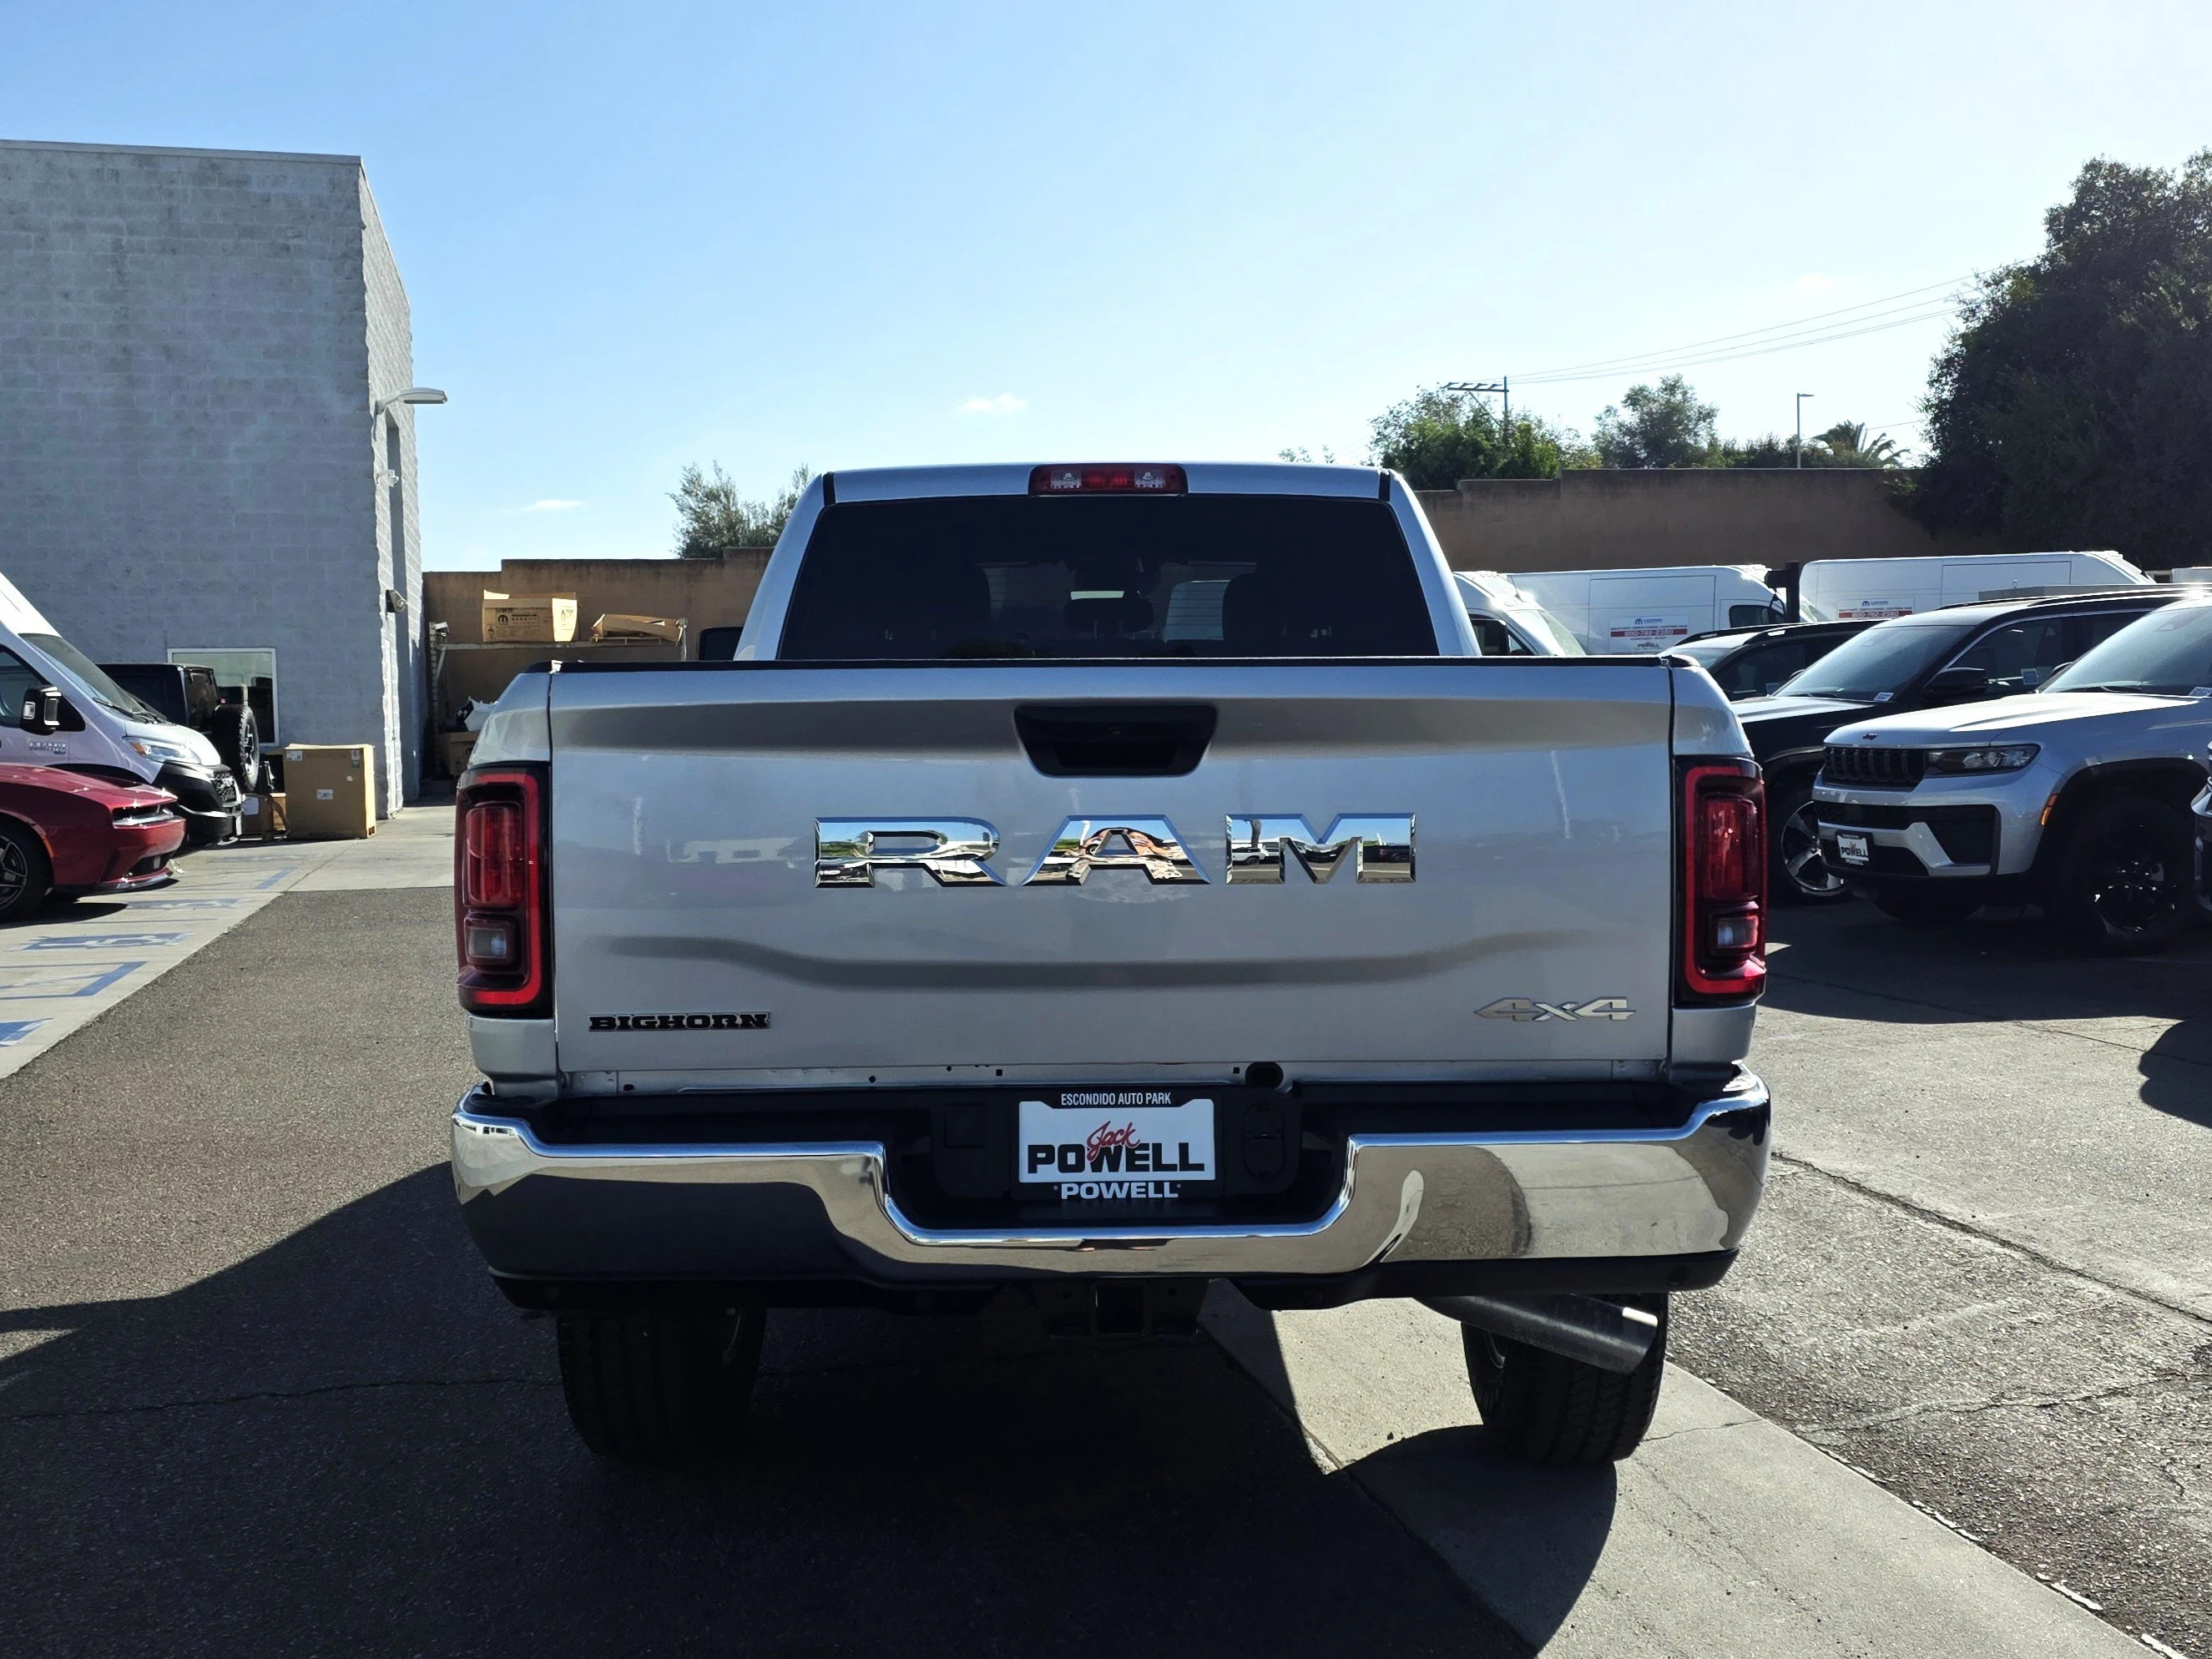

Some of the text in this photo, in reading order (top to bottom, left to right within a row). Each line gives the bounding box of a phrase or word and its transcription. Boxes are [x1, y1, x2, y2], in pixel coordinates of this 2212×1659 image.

[814, 813, 1417, 888] RAM
[588, 1011, 770, 1031] BIGHORN
[1061, 1092, 1171, 1106] ESCONDIDO AUTO PARK
[1086, 1120, 1141, 1162] Jack
[1028, 1142, 1204, 1174] POWELL
[1061, 1182, 1179, 1200] POWELL
